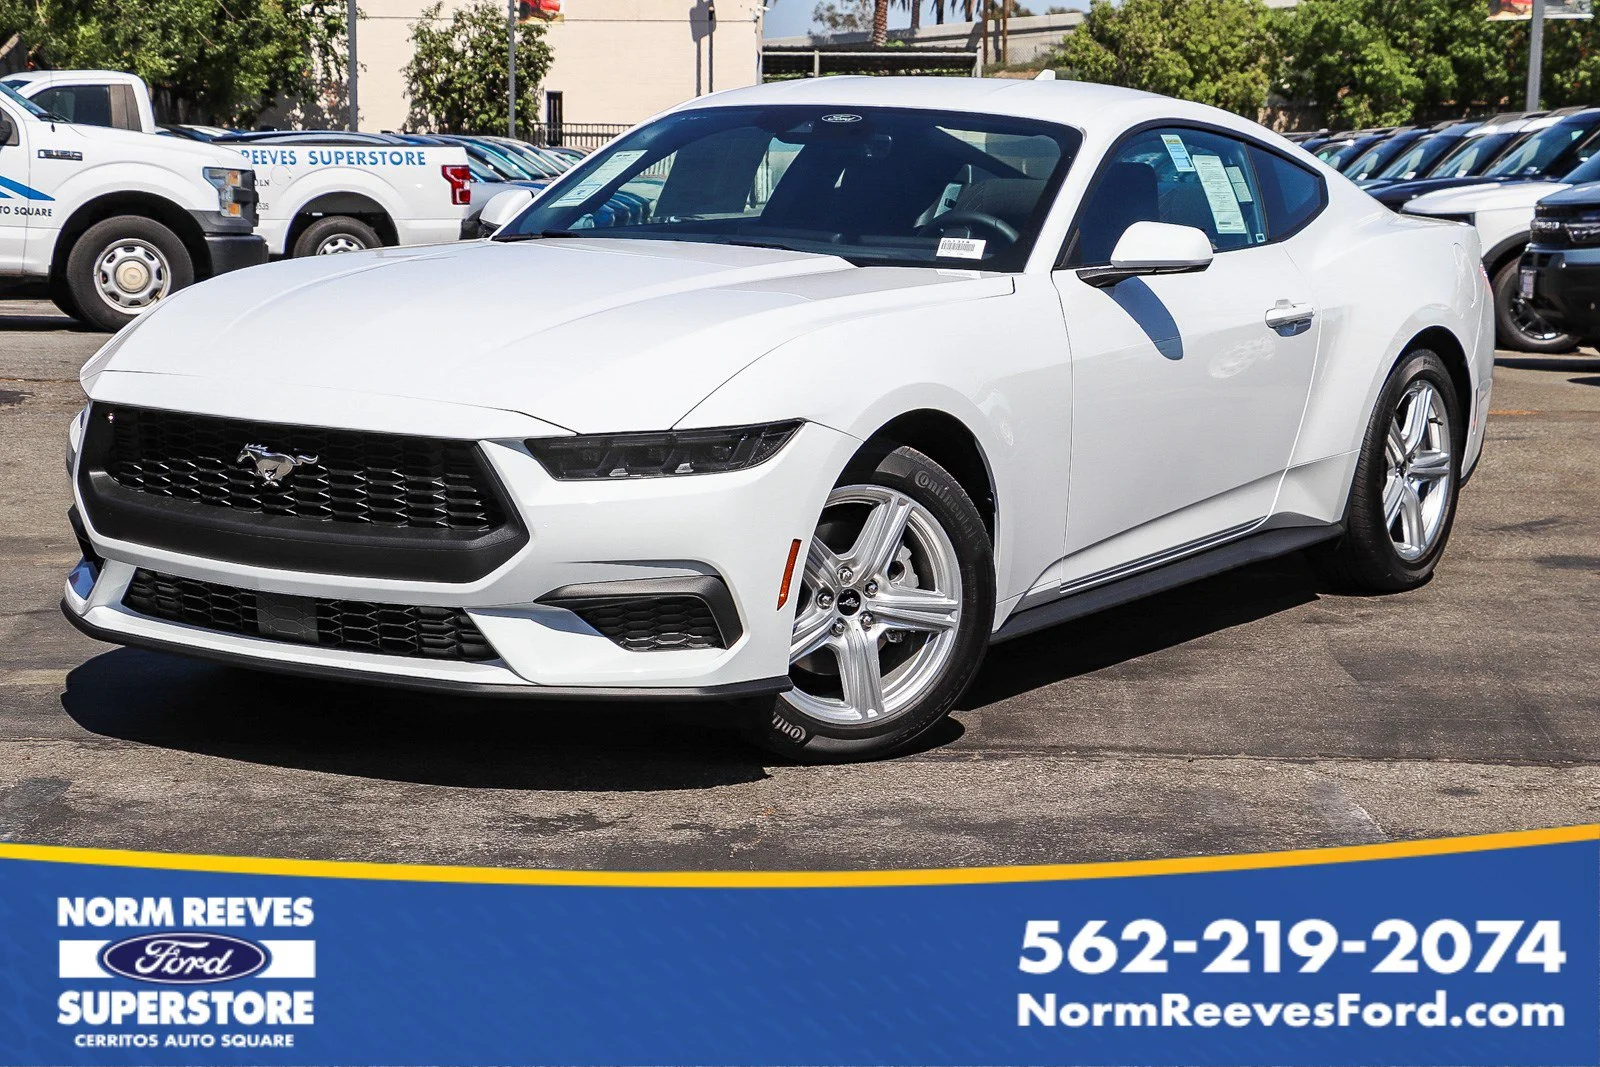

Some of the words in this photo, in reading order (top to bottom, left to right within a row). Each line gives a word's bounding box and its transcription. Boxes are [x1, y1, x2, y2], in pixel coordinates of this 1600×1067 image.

[241, 150, 297, 165] REEVES
[308, 150, 426, 165] SUPERSTORE
[14, 206, 53, 217] SQUARE
